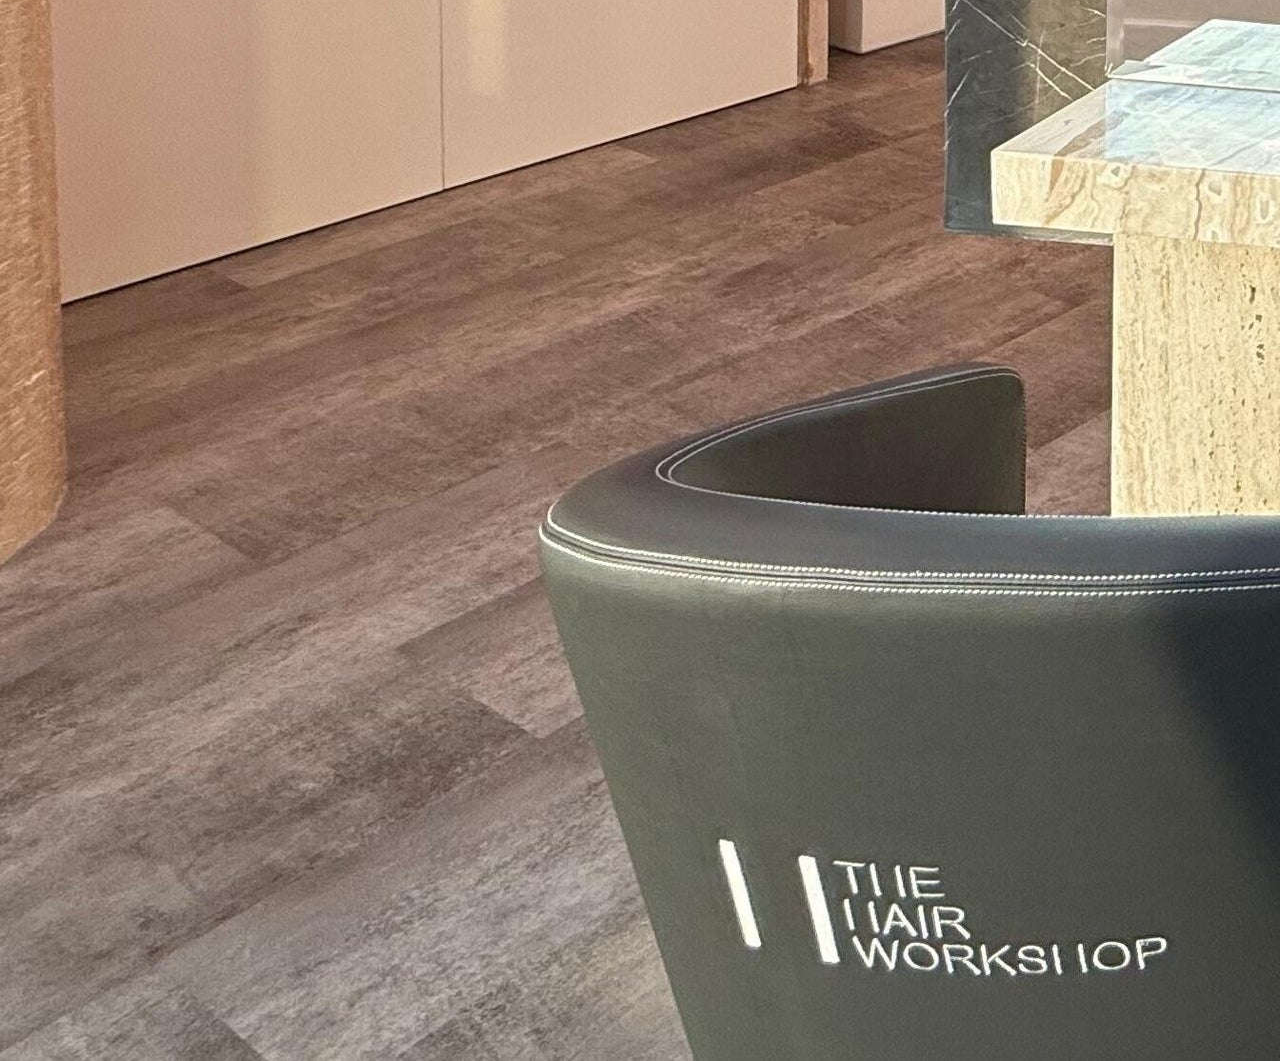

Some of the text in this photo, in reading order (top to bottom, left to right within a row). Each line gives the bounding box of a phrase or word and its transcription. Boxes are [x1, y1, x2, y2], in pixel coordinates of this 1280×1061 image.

[833, 859, 946, 899] THE
[842, 898, 971, 941] HAIR
[852, 935, 1168, 977] WORKSHOP
